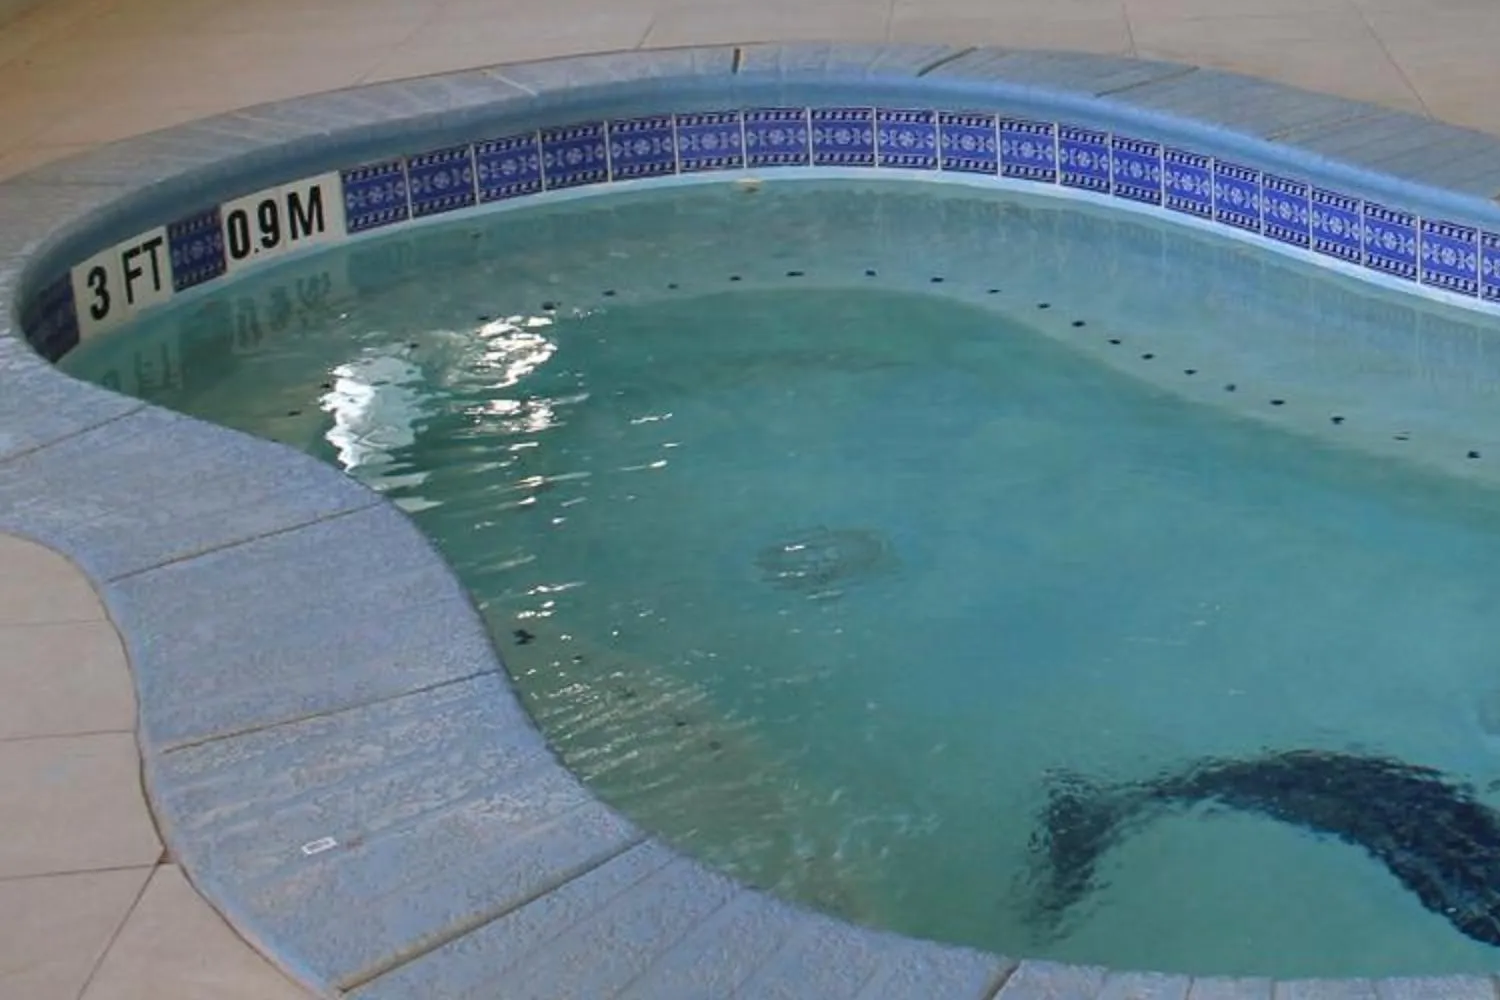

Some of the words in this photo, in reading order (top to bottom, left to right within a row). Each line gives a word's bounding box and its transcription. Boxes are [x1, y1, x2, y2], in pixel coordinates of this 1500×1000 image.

[87, 265, 111, 321] 3
[121, 236, 164, 305] FT
[226, 184, 326, 260] 0.9M
